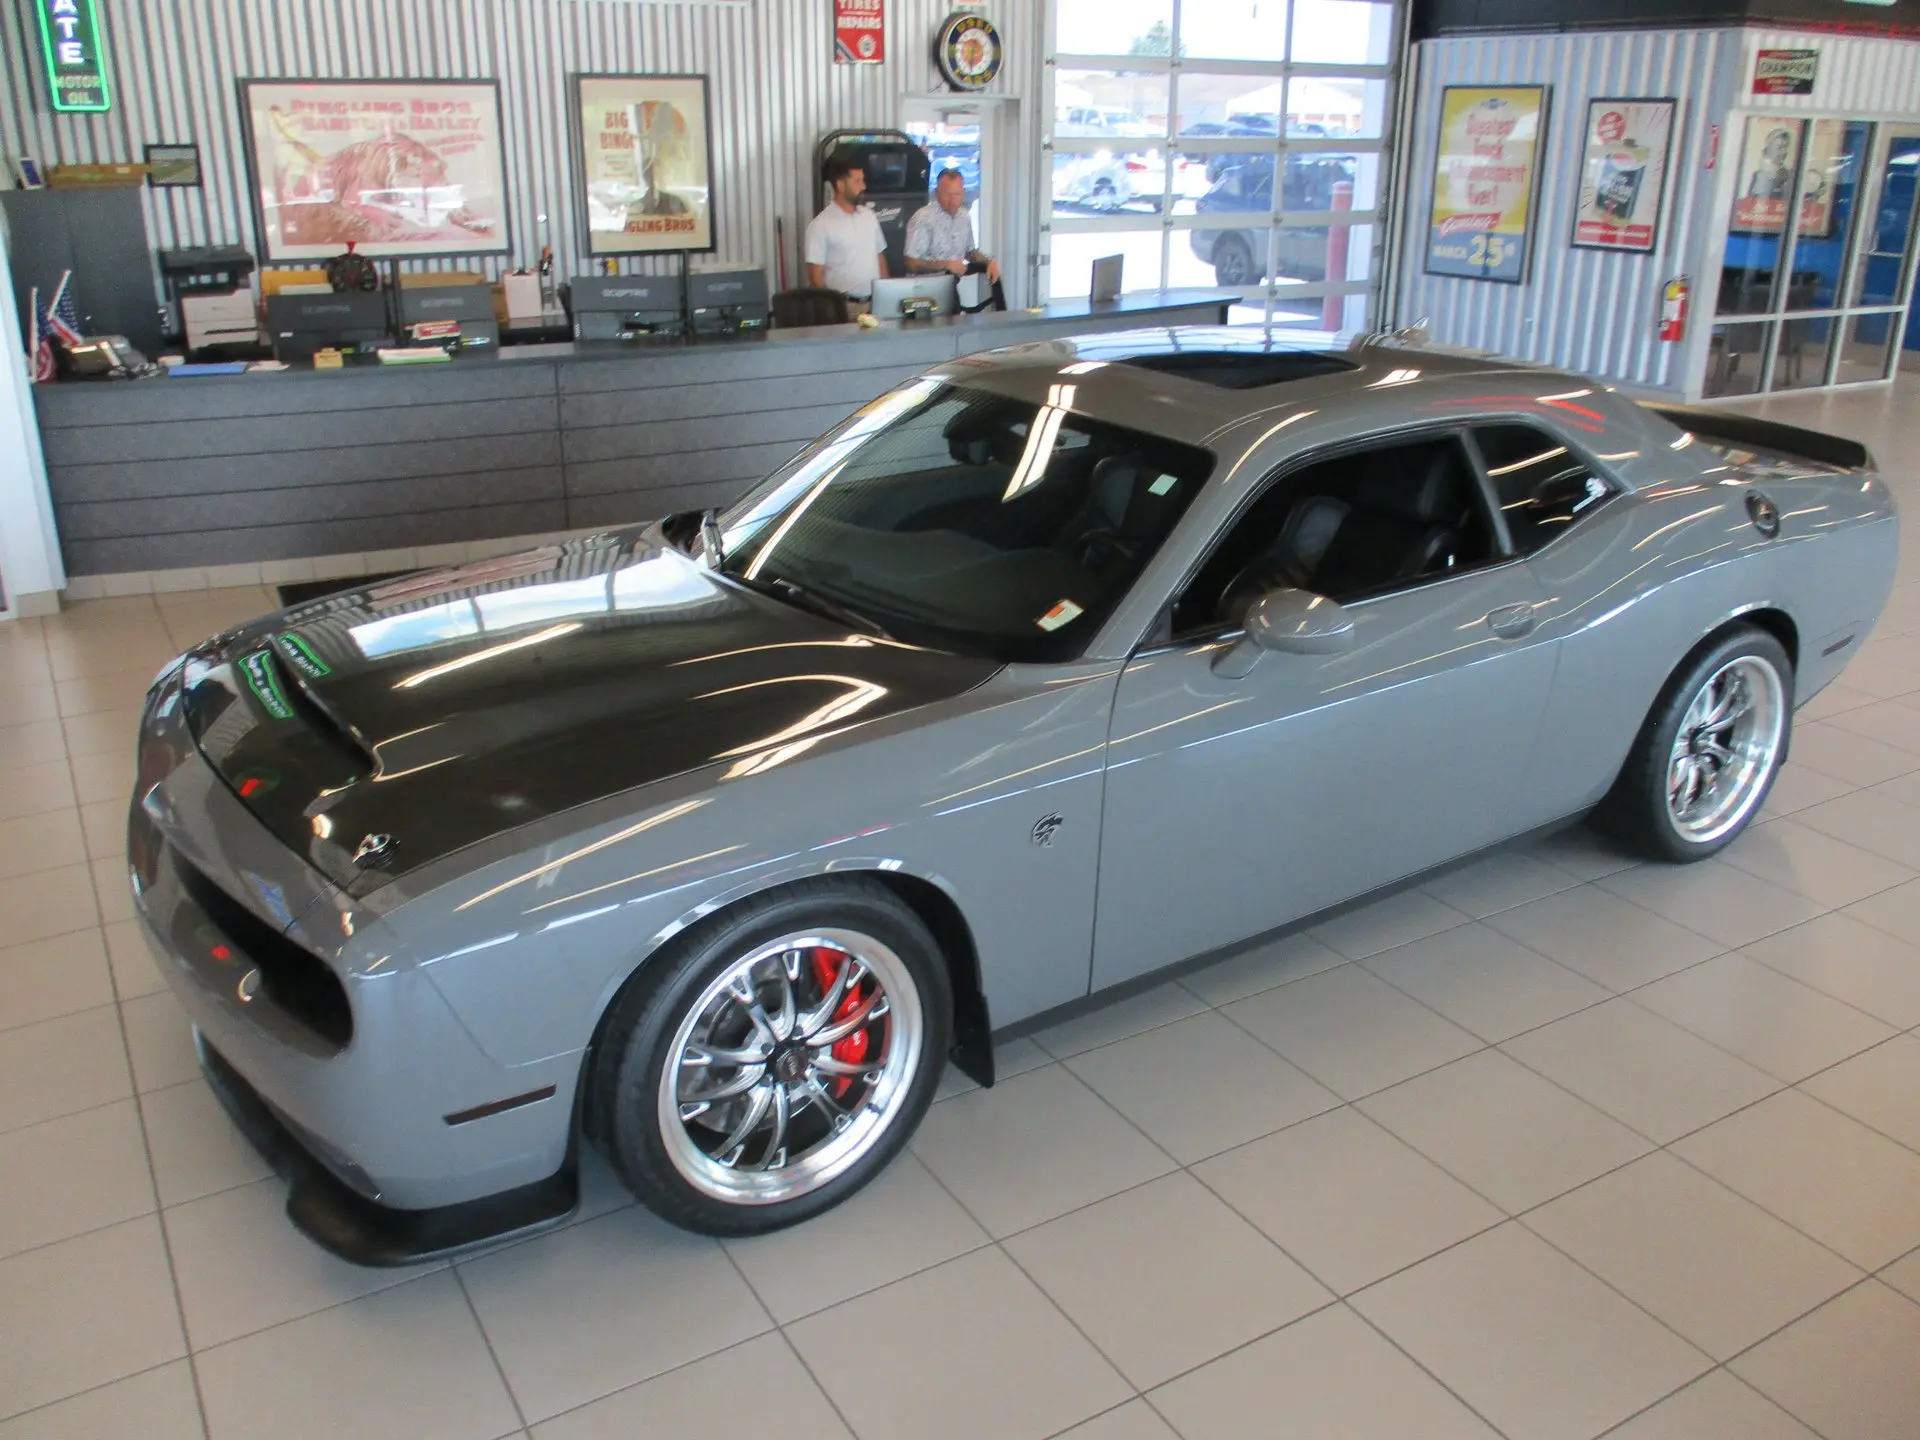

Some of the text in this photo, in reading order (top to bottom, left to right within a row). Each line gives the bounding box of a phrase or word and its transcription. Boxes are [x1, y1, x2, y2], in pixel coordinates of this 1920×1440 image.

[839, 0, 881, 10] TIRES
[837, 16, 882, 29] REPAIRS
[605, 110, 628, 129] BIG
